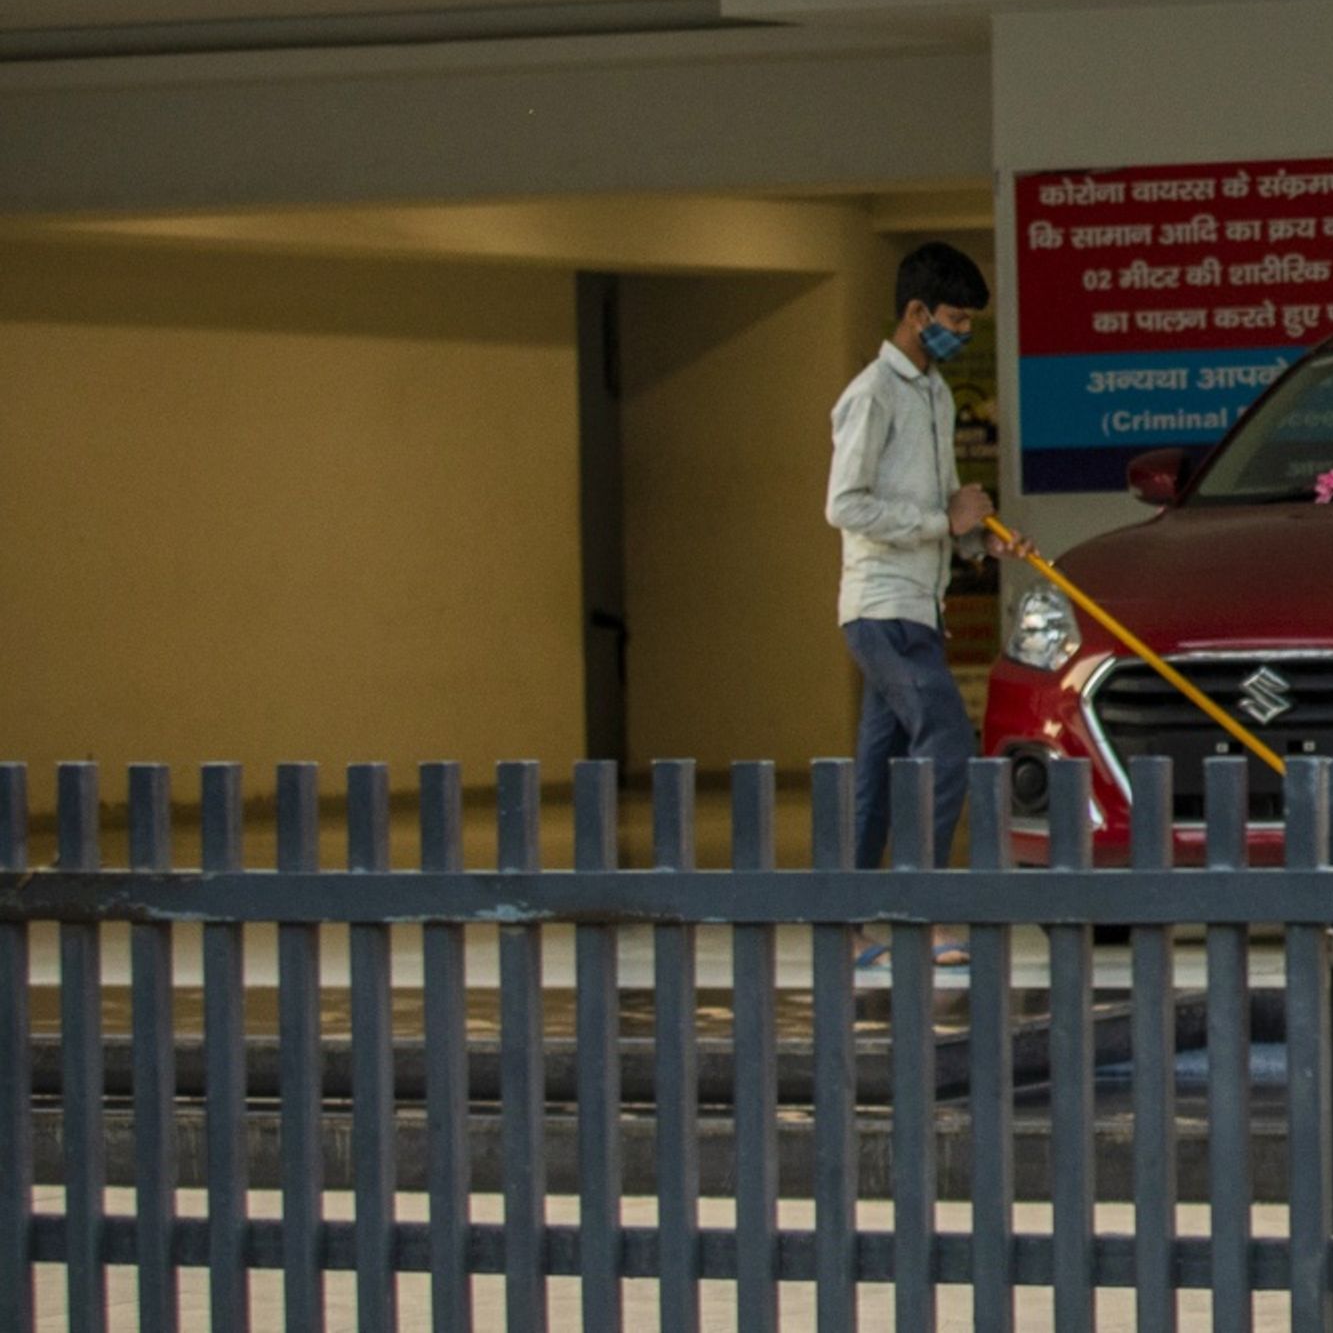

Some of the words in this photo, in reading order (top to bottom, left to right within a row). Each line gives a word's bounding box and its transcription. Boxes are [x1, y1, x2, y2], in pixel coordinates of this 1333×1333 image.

[1039, 177, 1126, 206] कोरोना
[1132, 178, 1216, 202] वायरस
[1222, 171, 1250, 198] के
[1028, 220, 1064, 250] कि
[1071, 224, 1153, 249] सामान
[1159, 213, 1218, 245] आदि
[1225, 220, 1261, 242] का
[1268, 217, 1315, 243] क्रय
[1083, 268, 1111, 291] 02
[1119, 260, 1181, 289] मीटर
[1186, 256, 1222, 287] की
[1229, 253, 1330, 286] शारीरिक
[1093, 311, 1129, 333] का
[1135, 308, 1207, 332] पालन
[1214, 299, 1276, 329] करते
[1282, 305, 1321, 338] हुए
[1086, 367, 1189, 393] अन्यथा
[1102, 407, 1228, 436] (Criminal
